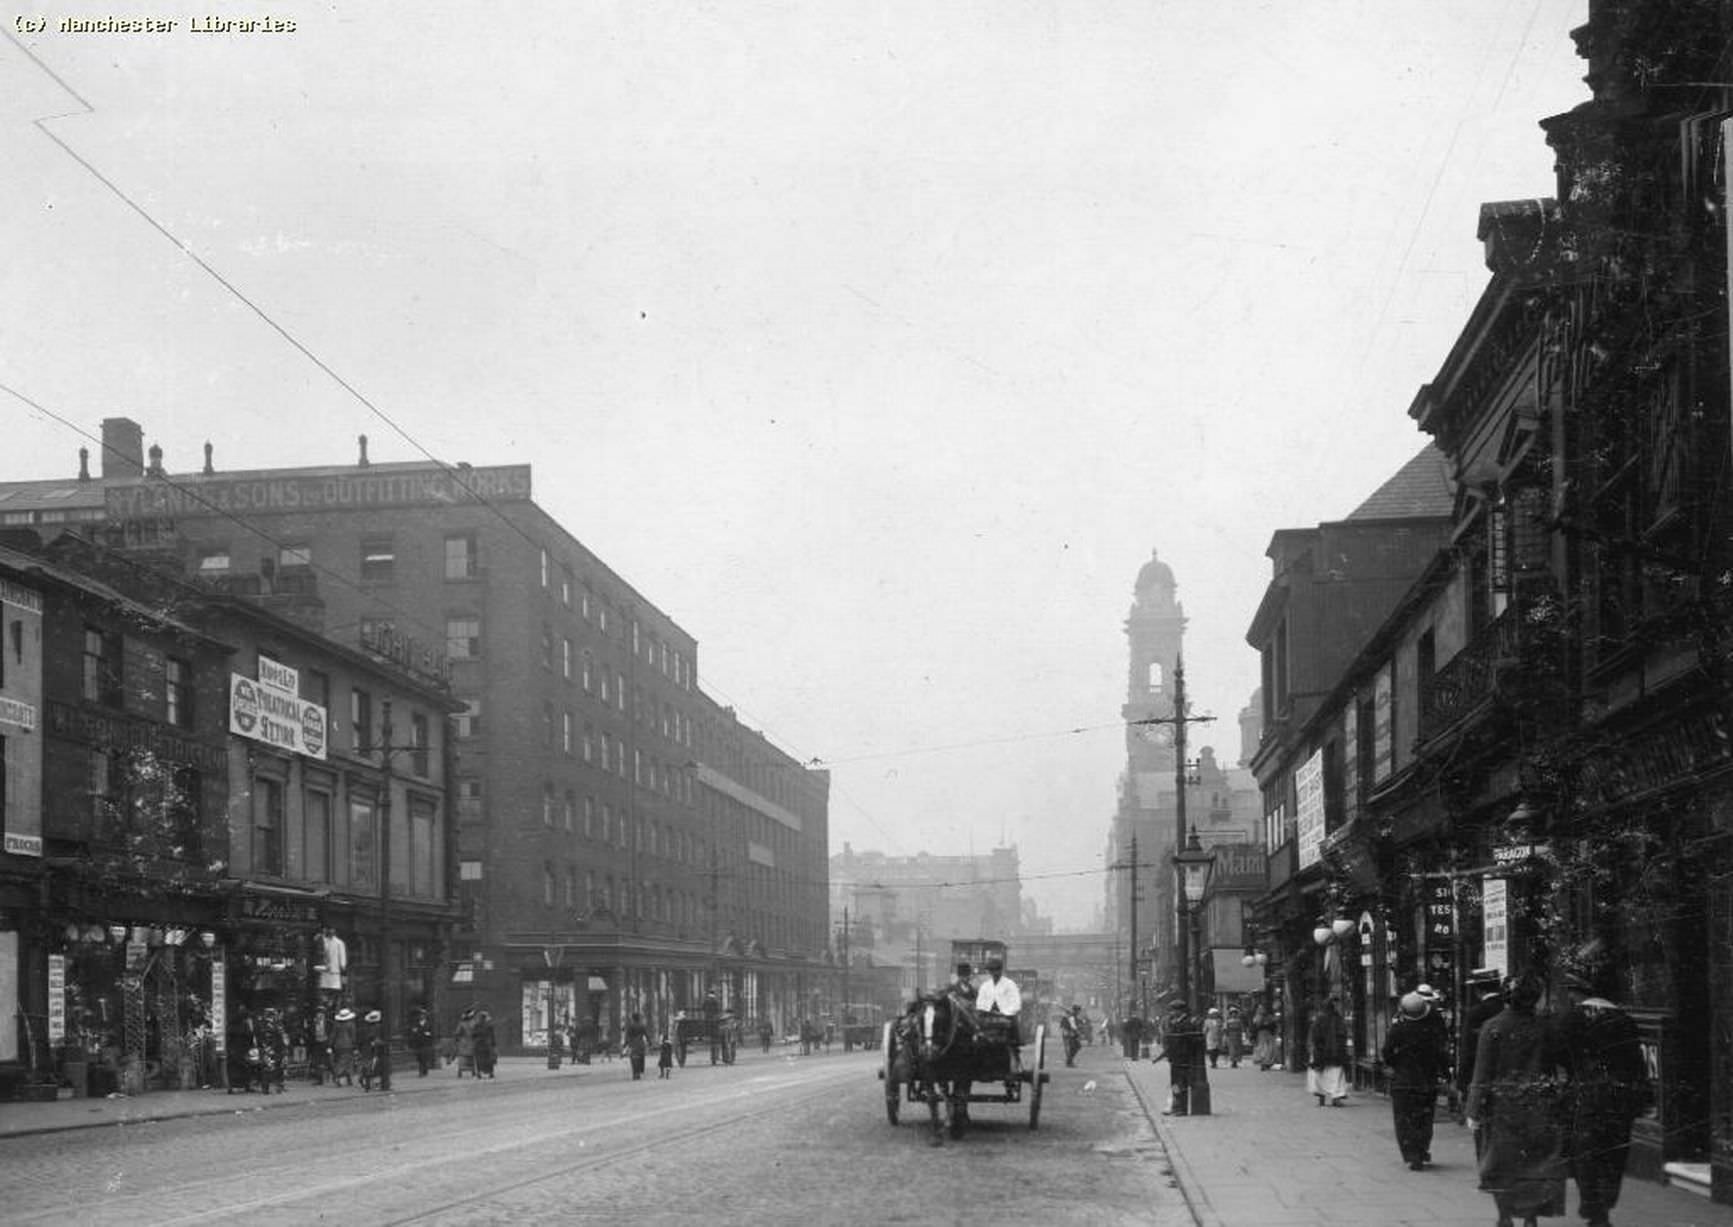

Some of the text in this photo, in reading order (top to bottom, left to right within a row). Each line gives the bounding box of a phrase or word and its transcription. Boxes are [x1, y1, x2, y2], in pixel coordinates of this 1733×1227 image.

[233, 480, 300, 511] SONS
[323, 474, 448, 505] OUTFITTING
[450, 470, 527, 500] WORKS
